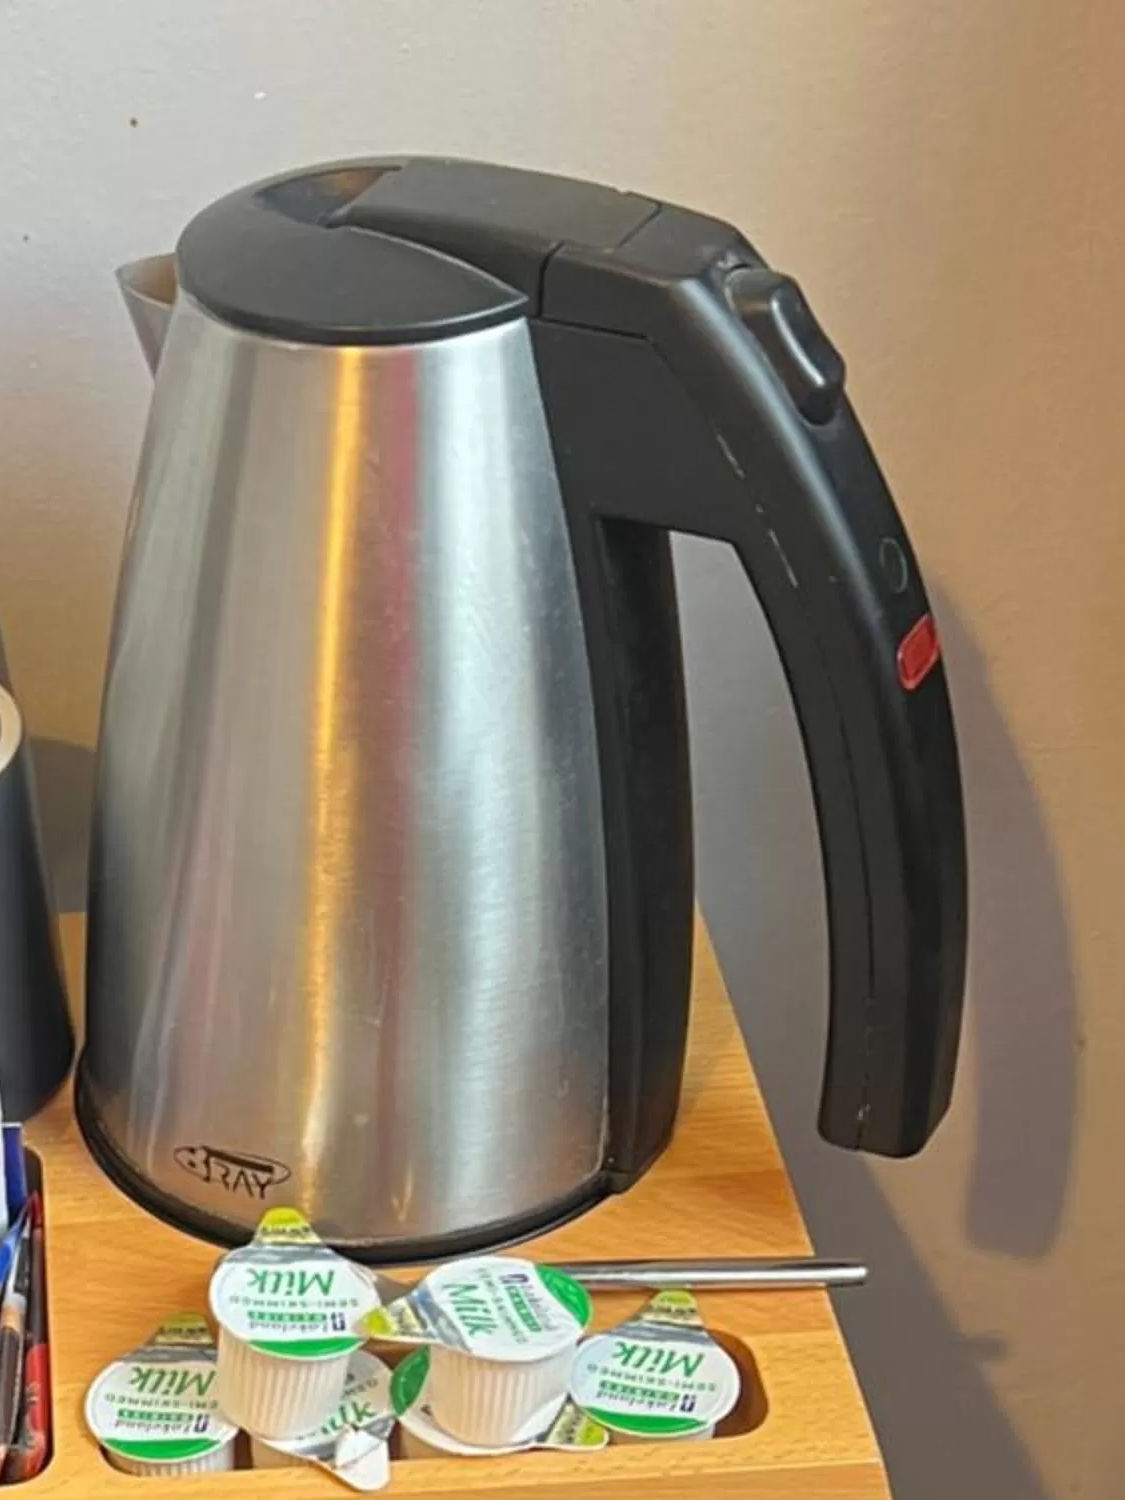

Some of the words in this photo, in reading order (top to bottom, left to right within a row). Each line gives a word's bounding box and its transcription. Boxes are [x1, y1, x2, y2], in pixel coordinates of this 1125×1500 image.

[245, 1266, 336, 1297] Milk
[442, 1281, 499, 1337] Milk
[611, 1340, 707, 1379] Milk
[127, 1365, 217, 1397] Milk
[104, 1393, 219, 1410] EMI-SKIMMED
